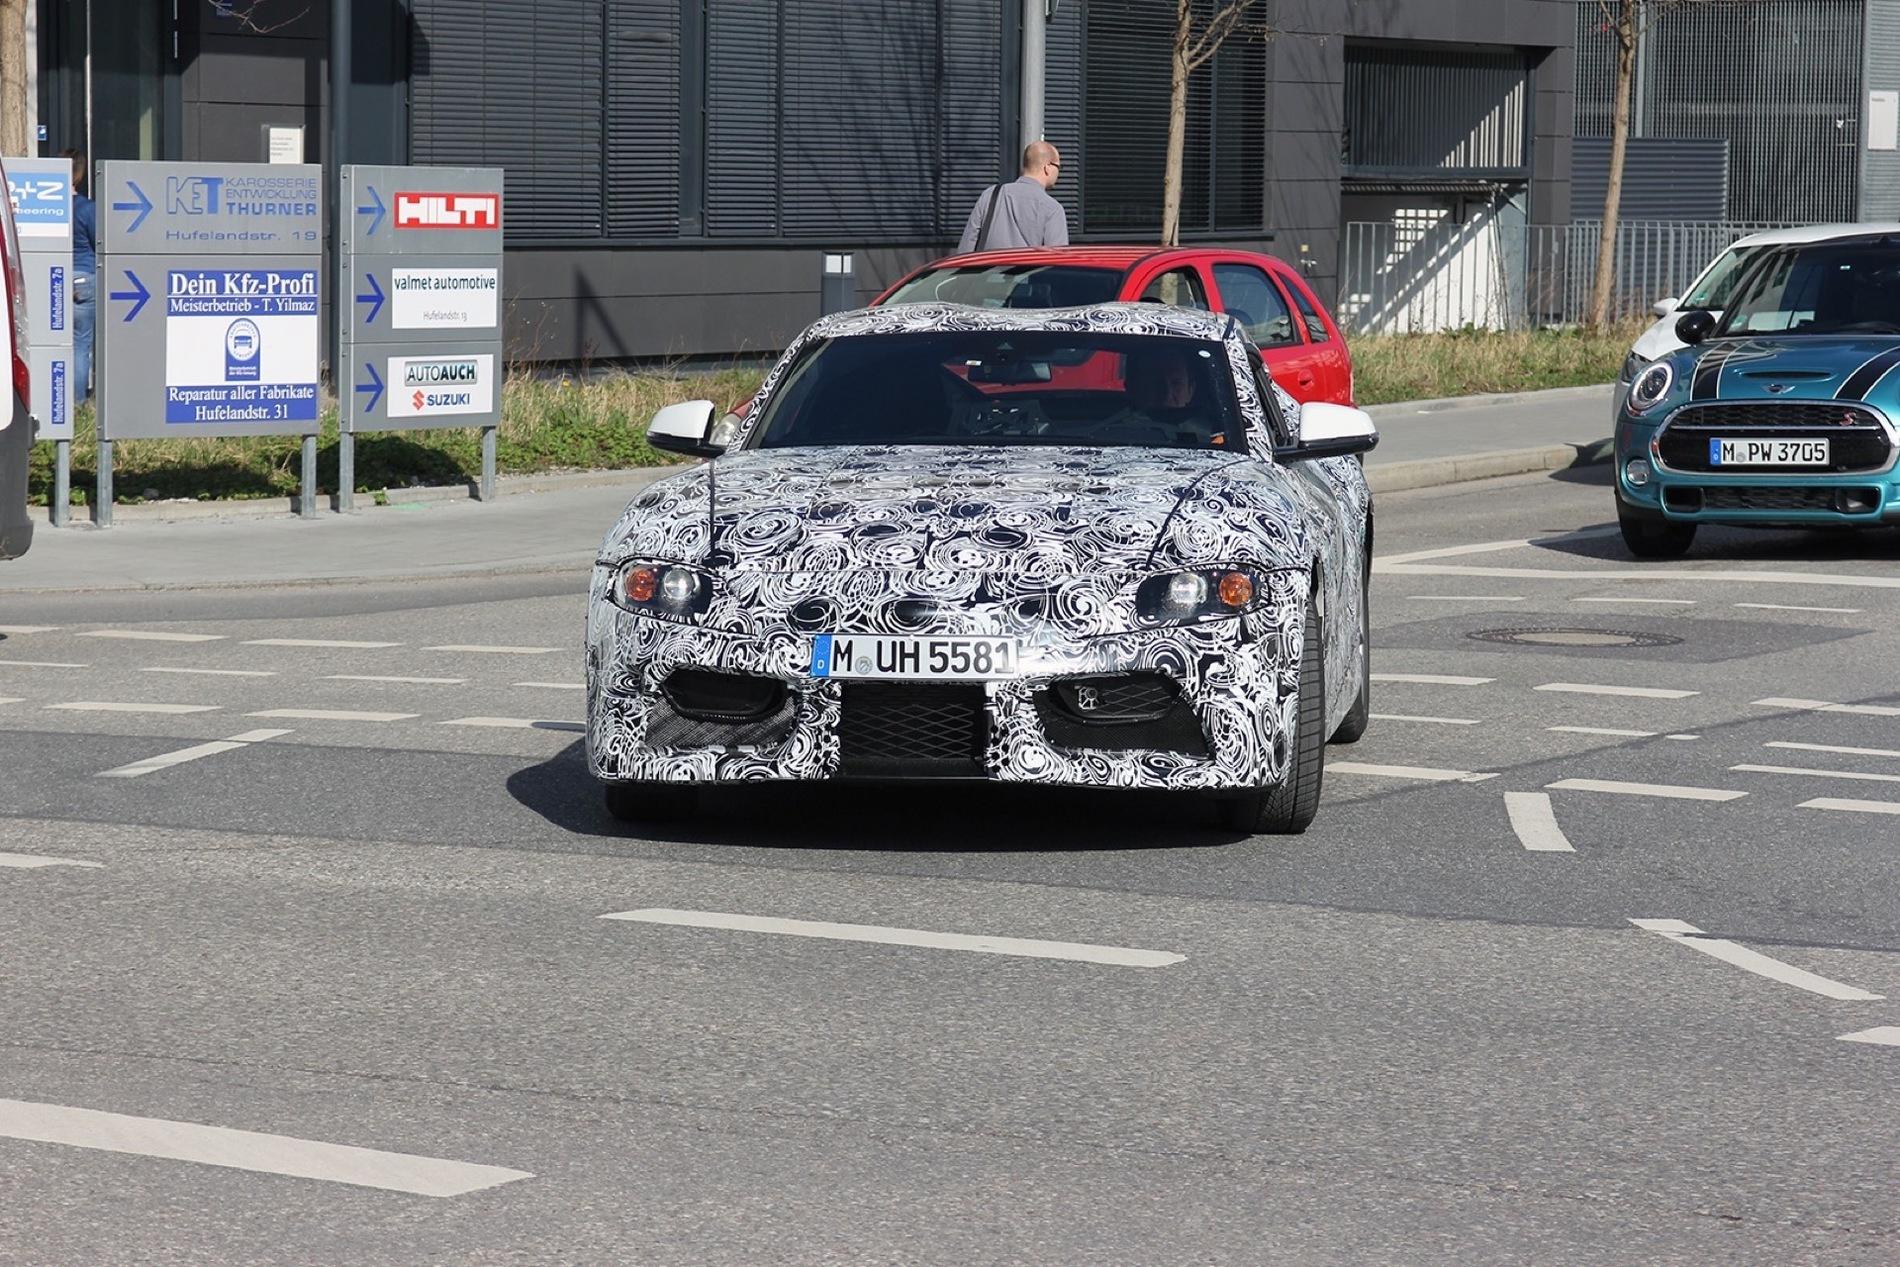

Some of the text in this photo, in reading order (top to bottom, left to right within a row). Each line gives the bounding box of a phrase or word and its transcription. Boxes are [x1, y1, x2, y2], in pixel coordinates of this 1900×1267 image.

[226, 178, 317, 187] KAROSSERIE
[166, 176, 224, 215] KET
[226, 189, 317, 199] ENTWICKLUNG
[226, 202, 317, 216] THURNER
[399, 196, 495, 225] HILTI
[166, 230, 317, 241] Hufelandstr. 19
[171, 273, 315, 294] Dein Kfz-Profi
[394, 274, 495, 290] valmet automotive
[52, 267, 64, 329] Hufelandstr. 7a
[170, 298, 252, 312] Meisterbetrieb
[262, 298, 273, 312] T.
[277, 298, 315, 312] Yilmaz
[407, 365, 475, 382] AUTOAUCH
[169, 385, 314, 405] Reparatur aller Fabrikate
[427, 393, 470, 406] SUZUKI
[195, 404, 288, 421] Hufelandstr. 31
[1722, 442, 1735, 462] M
[1748, 442, 1773, 462] PW
[1777, 442, 1826, 462] 3705
[832, 639, 854, 672] M
[876, 640, 920, 673] UH
[929, 641, 1015, 674] 5581
